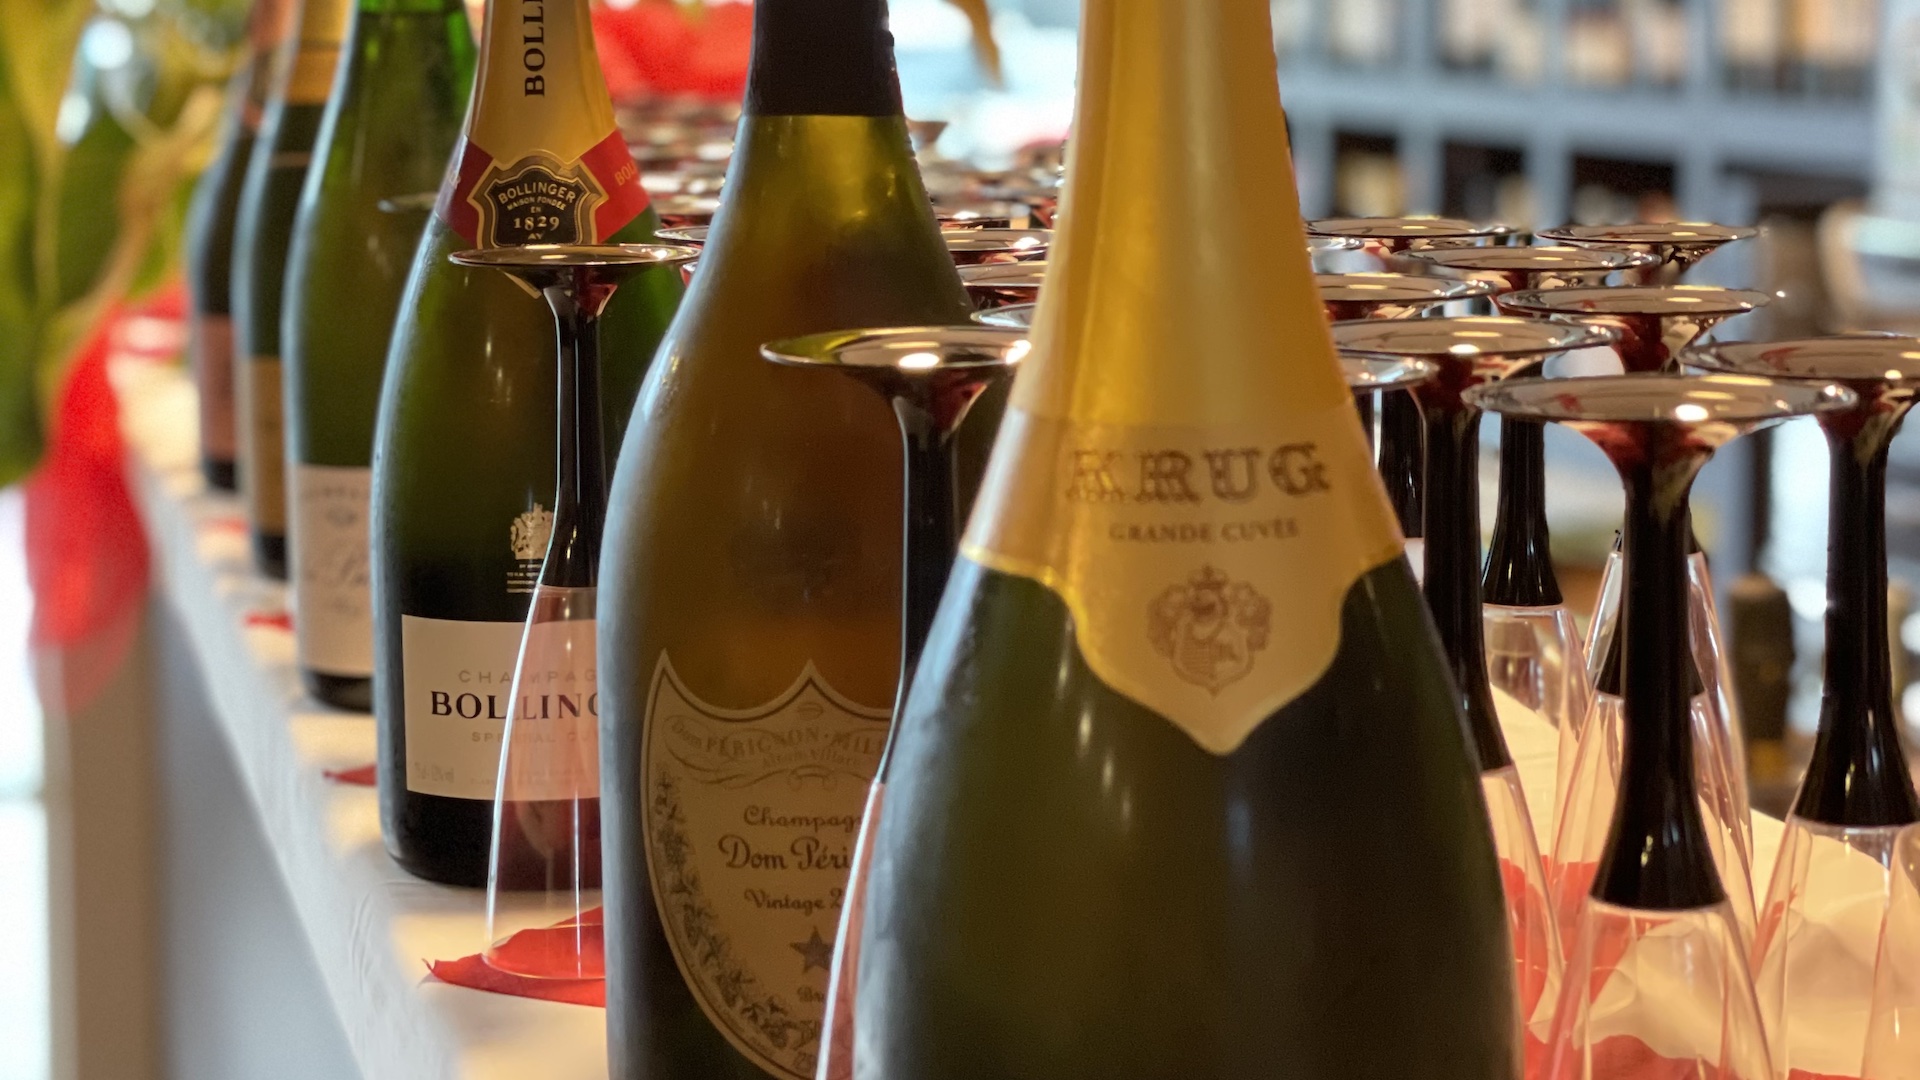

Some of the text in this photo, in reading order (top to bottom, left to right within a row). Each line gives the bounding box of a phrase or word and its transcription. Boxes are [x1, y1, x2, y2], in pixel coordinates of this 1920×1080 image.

[523, 0, 544, 97] BOLL
[498, 182, 576, 204] BOLLINGER
[507, 196, 535, 211] MAISON
[513, 216, 560, 231] 1829
[1066, 441, 1332, 504] KRUG
[1108, 521, 1211, 543] GRANDE
[718, 834, 851, 871] Dom Péri
[744, 887, 827, 916] Vintage
